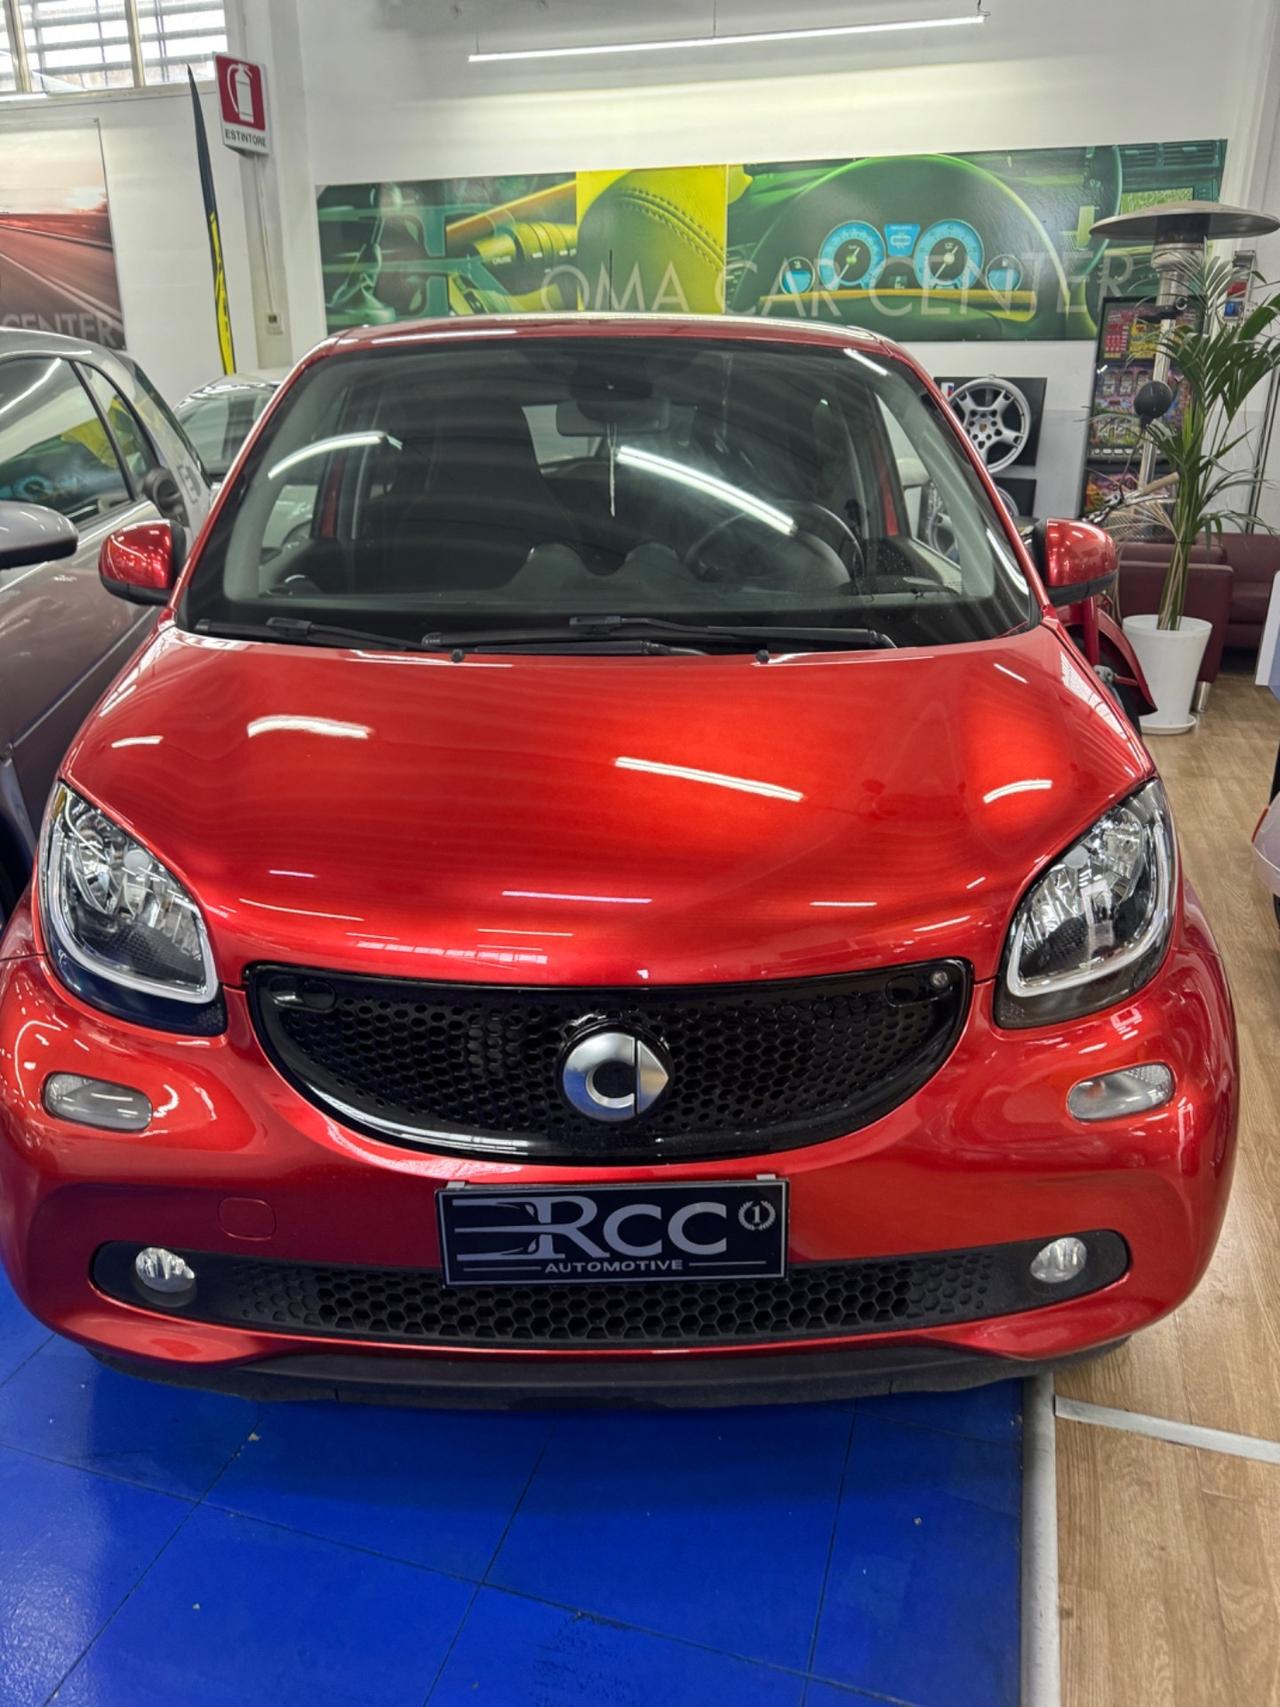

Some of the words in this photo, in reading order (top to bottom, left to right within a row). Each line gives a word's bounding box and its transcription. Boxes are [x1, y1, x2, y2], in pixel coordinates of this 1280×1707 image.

[225, 128, 267, 147] ESTINTORE
[714, 256, 841, 317] CAR
[869, 252, 1134, 317] CENTER
[545, 1259, 683, 1273] AUTOMOTIVE
